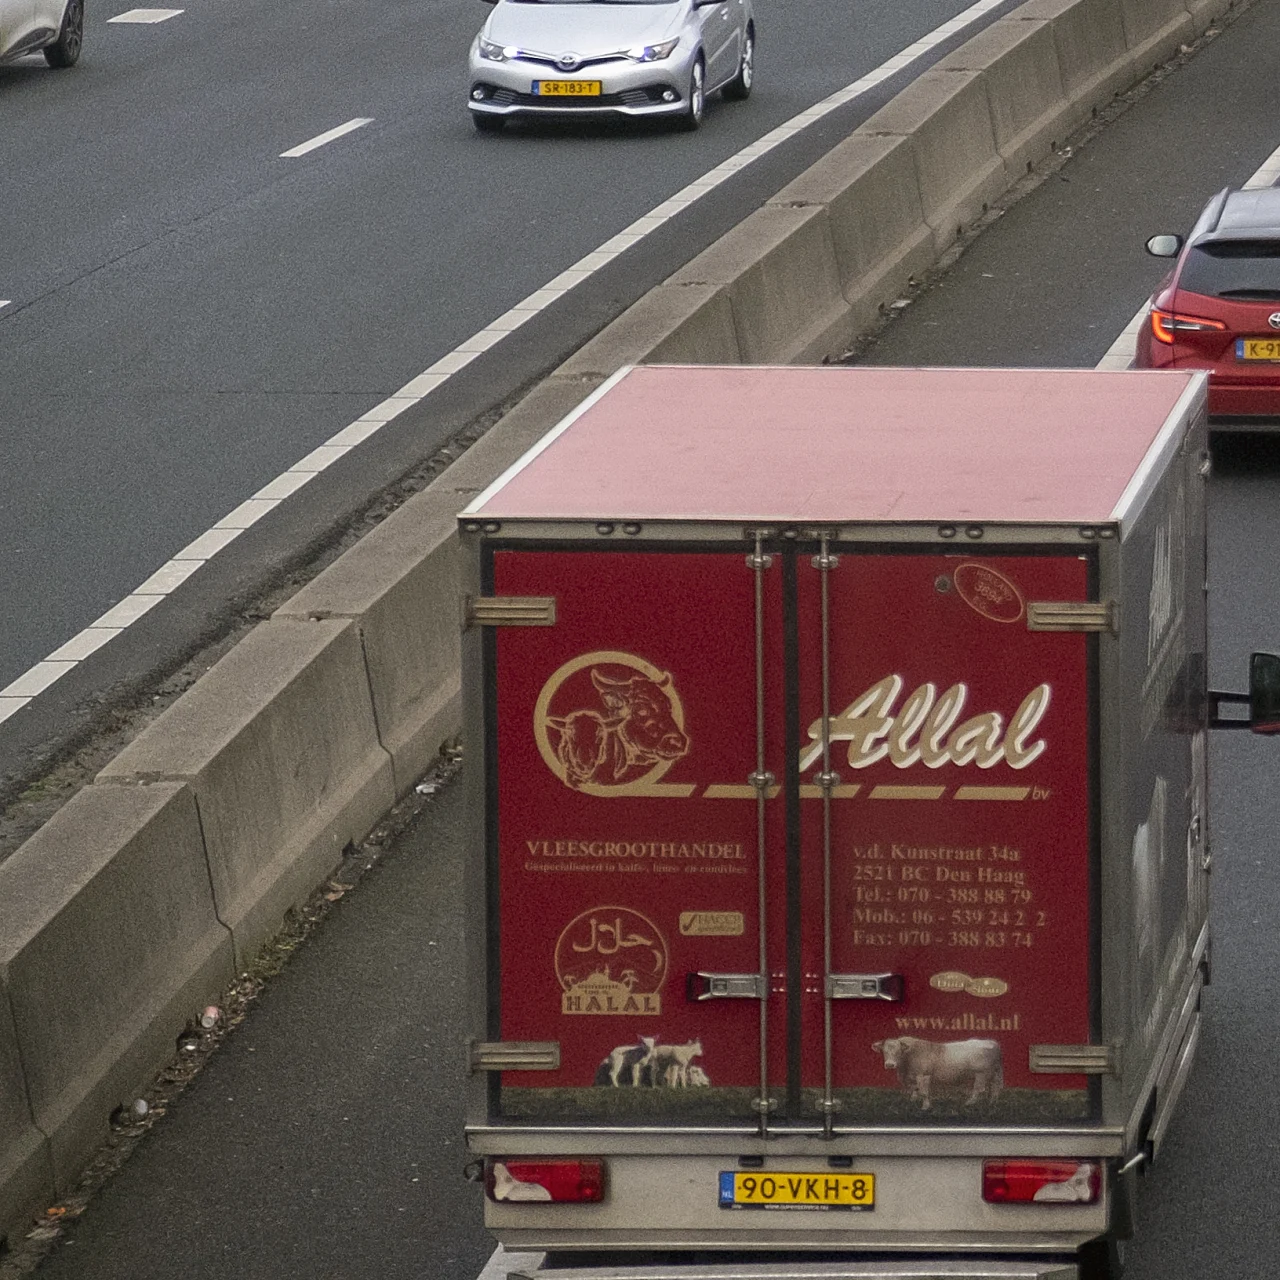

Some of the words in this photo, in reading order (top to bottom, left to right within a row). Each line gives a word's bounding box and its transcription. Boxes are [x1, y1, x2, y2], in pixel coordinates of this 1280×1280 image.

[543, 82, 594, 94] SR-183-T
[798, 673, 1051, 770] Allal
[1031, 786, 1051, 800] bv
[525, 840, 747, 860] VLEESGROOTHANDEL
[853, 843, 884, 860] v.d.
[891, 844, 983, 861] Kunstraat
[987, 845, 1021, 862] 34a
[853, 865, 893, 881] 2521
[901, 866, 931, 882] BC
[936, 866, 971, 883] Den
[977, 867, 1025, 887] Haag
[854, 886, 892, 903] Tel.:
[898, 887, 929, 903] 070
[948, 888, 978, 904] 388
[984, 888, 1005, 904] 88
[1011, 889, 1032, 905] 79
[853, 908, 906, 925] Mob.:
[912, 909, 933, 925] 06
[951, 910, 983, 926] 539
[988, 910, 1009, 927] 24
[572, 917, 653, 956] حلال
[853, 930, 893, 946] Fax:
[899, 930, 931, 946] 070
[948, 931, 979, 947] 388
[984, 931, 1006, 947] 83
[1011, 932, 1033, 948] 74
[566, 995, 657, 1012] HALAL
[895, 1013, 1021, 1031] www.allal.nl
[721, 1190, 733, 1200] NL
[741, 1177, 867, 1202] 90-VKH-8
